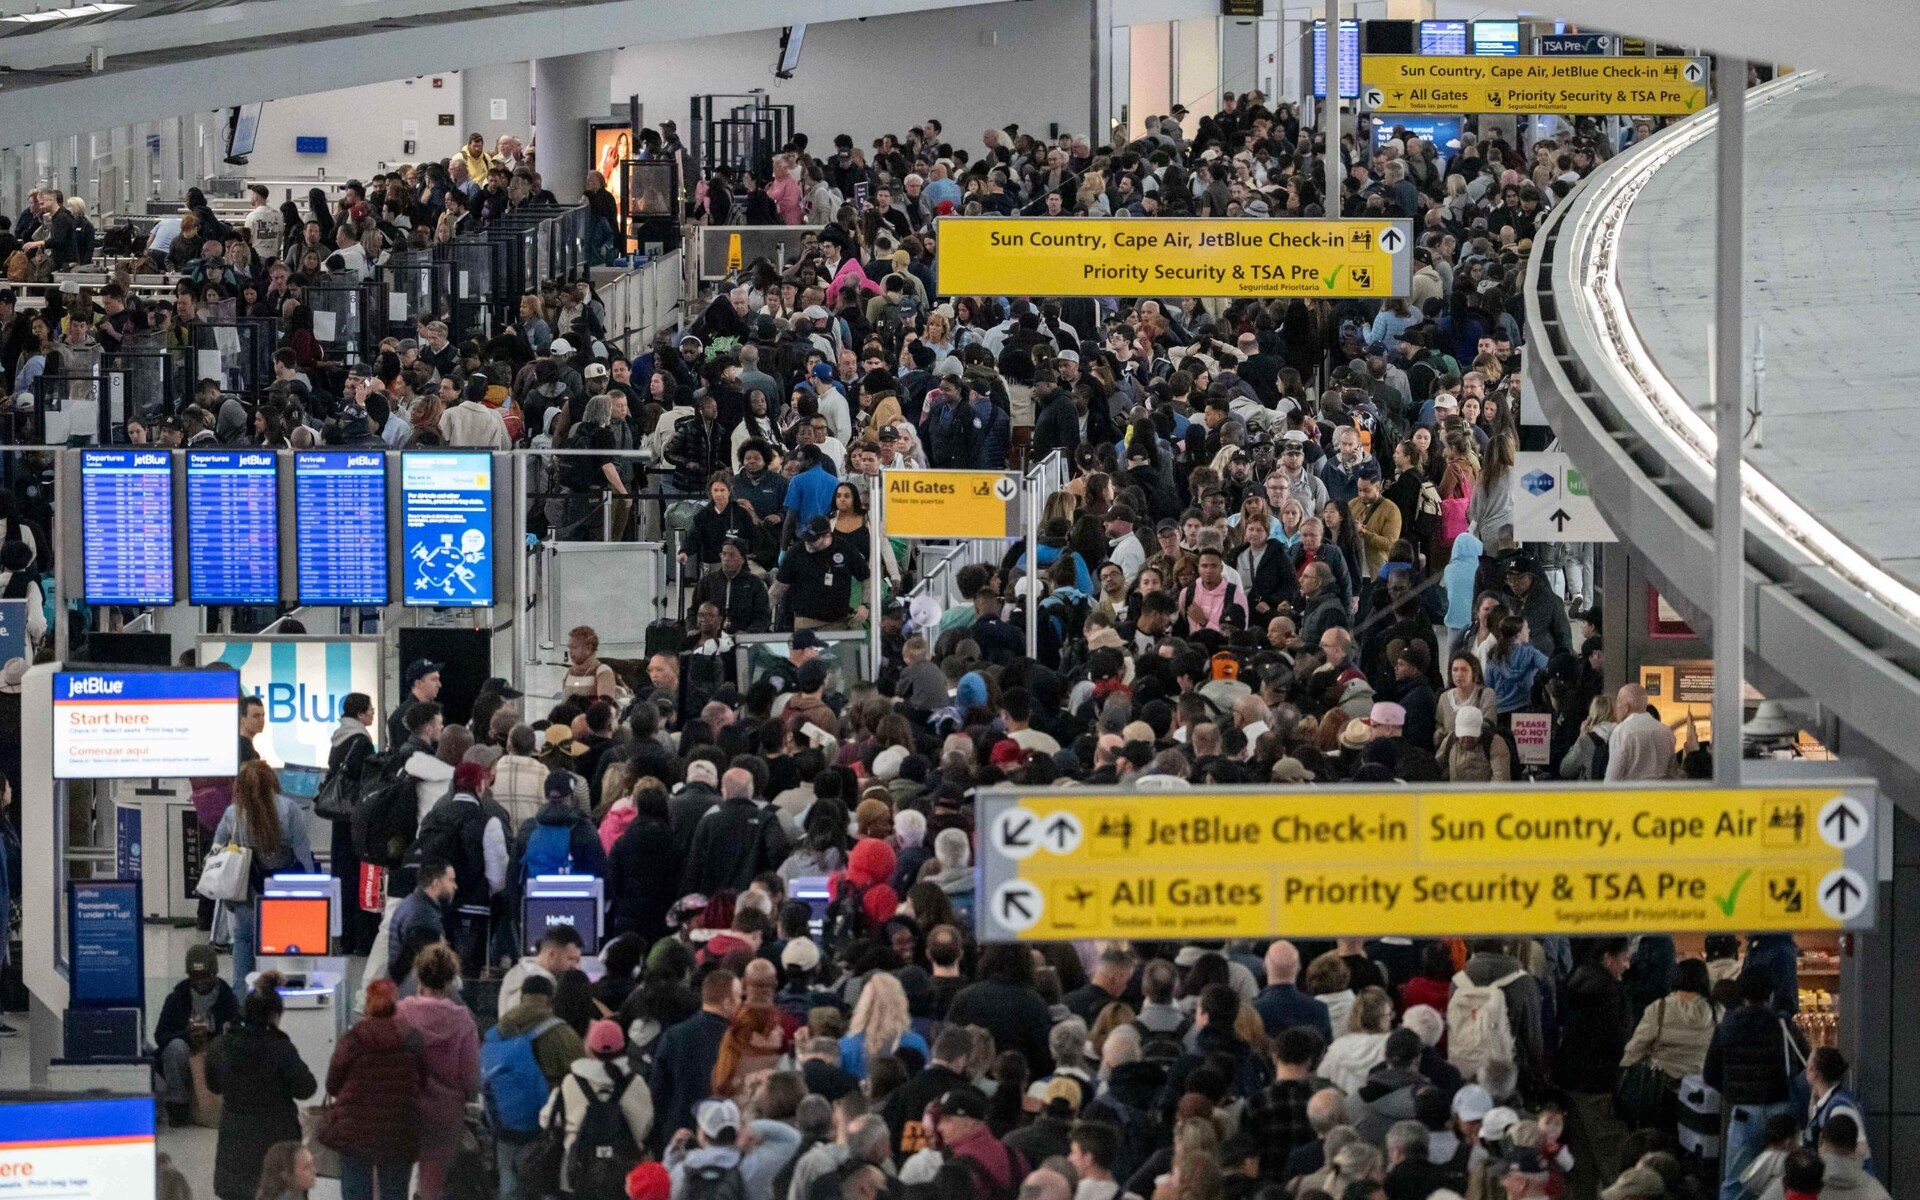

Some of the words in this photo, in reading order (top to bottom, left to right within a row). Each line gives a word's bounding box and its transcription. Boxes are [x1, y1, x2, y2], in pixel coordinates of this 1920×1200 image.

[1544, 41, 1564, 51] TSA
[1565, 41, 1581, 51] Pre
[1401, 65, 1425, 76] Sun
[1430, 65, 1486, 80] Country,
[1491, 65, 1523, 80] Cape
[1527, 66, 1548, 78] Air,
[1552, 66, 1598, 78] JetBlue
[1602, 66, 1658, 78] Check-in
[1410, 90, 1426, 100] All
[1432, 90, 1468, 100] Gates
[1508, 90, 1556, 104] Priority
[1560, 90, 1612, 104] Security
[1617, 90, 1626, 102] &
[1630, 90, 1656, 102] TSA
[1660, 90, 1680, 102] Pre
[990, 232, 1023, 246] Sun
[1030, 232, 1106, 250] Country,
[1114, 232, 1157, 250] Cape
[1164, 232, 1192, 249] Air,
[1198, 232, 1262, 247] JetBlue
[1268, 231, 1344, 247] Check-in
[1084, 264, 1148, 282] Priority
[1155, 264, 1226, 282] Security
[1232, 265, 1244, 279] &
[1250, 265, 1284, 279] TSA
[1292, 265, 1319, 279] Pre
[1238, 284, 1278, 292] Seguridad
[86, 454, 125, 463] Departures
[134, 454, 166, 466] jetBlue
[191, 455, 230, 463] Departures
[239, 455, 271, 467] jetBlue
[347, 456, 380, 468] jetBlue
[890, 480, 909, 493] All
[914, 480, 955, 494] Gates
[68, 677, 123, 698] jetBlue
[70, 712, 110, 725] Start
[115, 712, 149, 724] here
[69, 747, 123, 756] Comenzar
[1146, 814, 1261, 846] JetBlue
[1272, 813, 1408, 844] Check-in
[1430, 812, 1483, 842] Sun
[1495, 812, 1621, 848] Country,
[1632, 811, 1704, 846] Cape
[1715, 810, 1757, 837] Air
[1111, 878, 1154, 906] All
[1168, 878, 1262, 907] Gates
[1285, 875, 1401, 911] Priority
[1413, 873, 1539, 907] Security
[1552, 874, 1573, 900] &
[1585, 873, 1646, 899] TSA
[1657, 872, 1706, 898] Pre
[83, 911, 104, 919] under
[1113, 914, 1152, 928] Todas
[1159, 914, 1179, 928] las
[1182, 914, 1236, 930] puertas
[1555, 907, 1630, 925] Seguridad
[1633, 906, 1706, 921] Prioritaria
